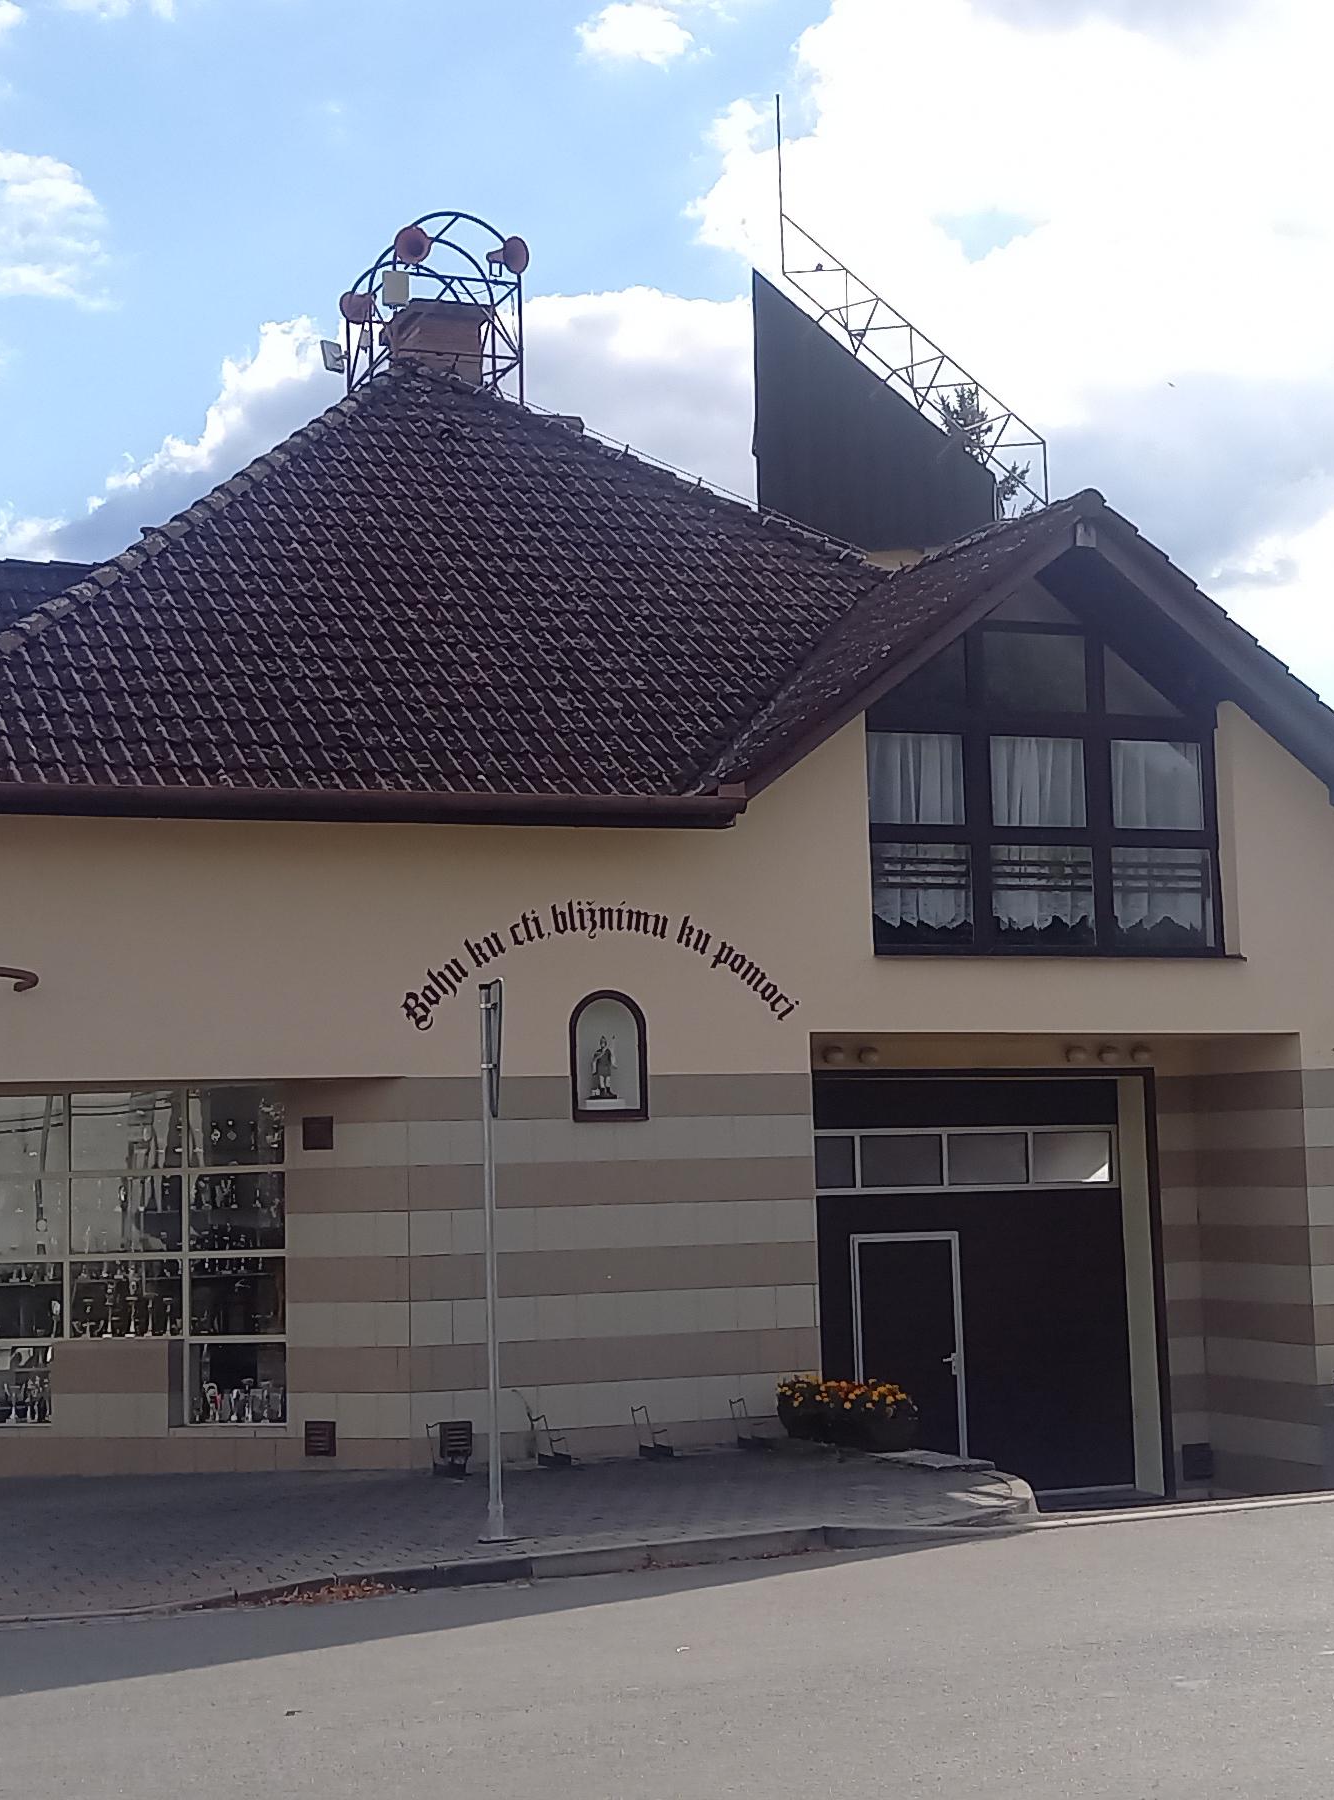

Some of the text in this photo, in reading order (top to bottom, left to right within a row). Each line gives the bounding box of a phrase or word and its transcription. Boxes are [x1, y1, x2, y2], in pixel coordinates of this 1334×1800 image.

[400, 899, 799, 1031] Bohu ku cti, bližnímu ku pomoci
